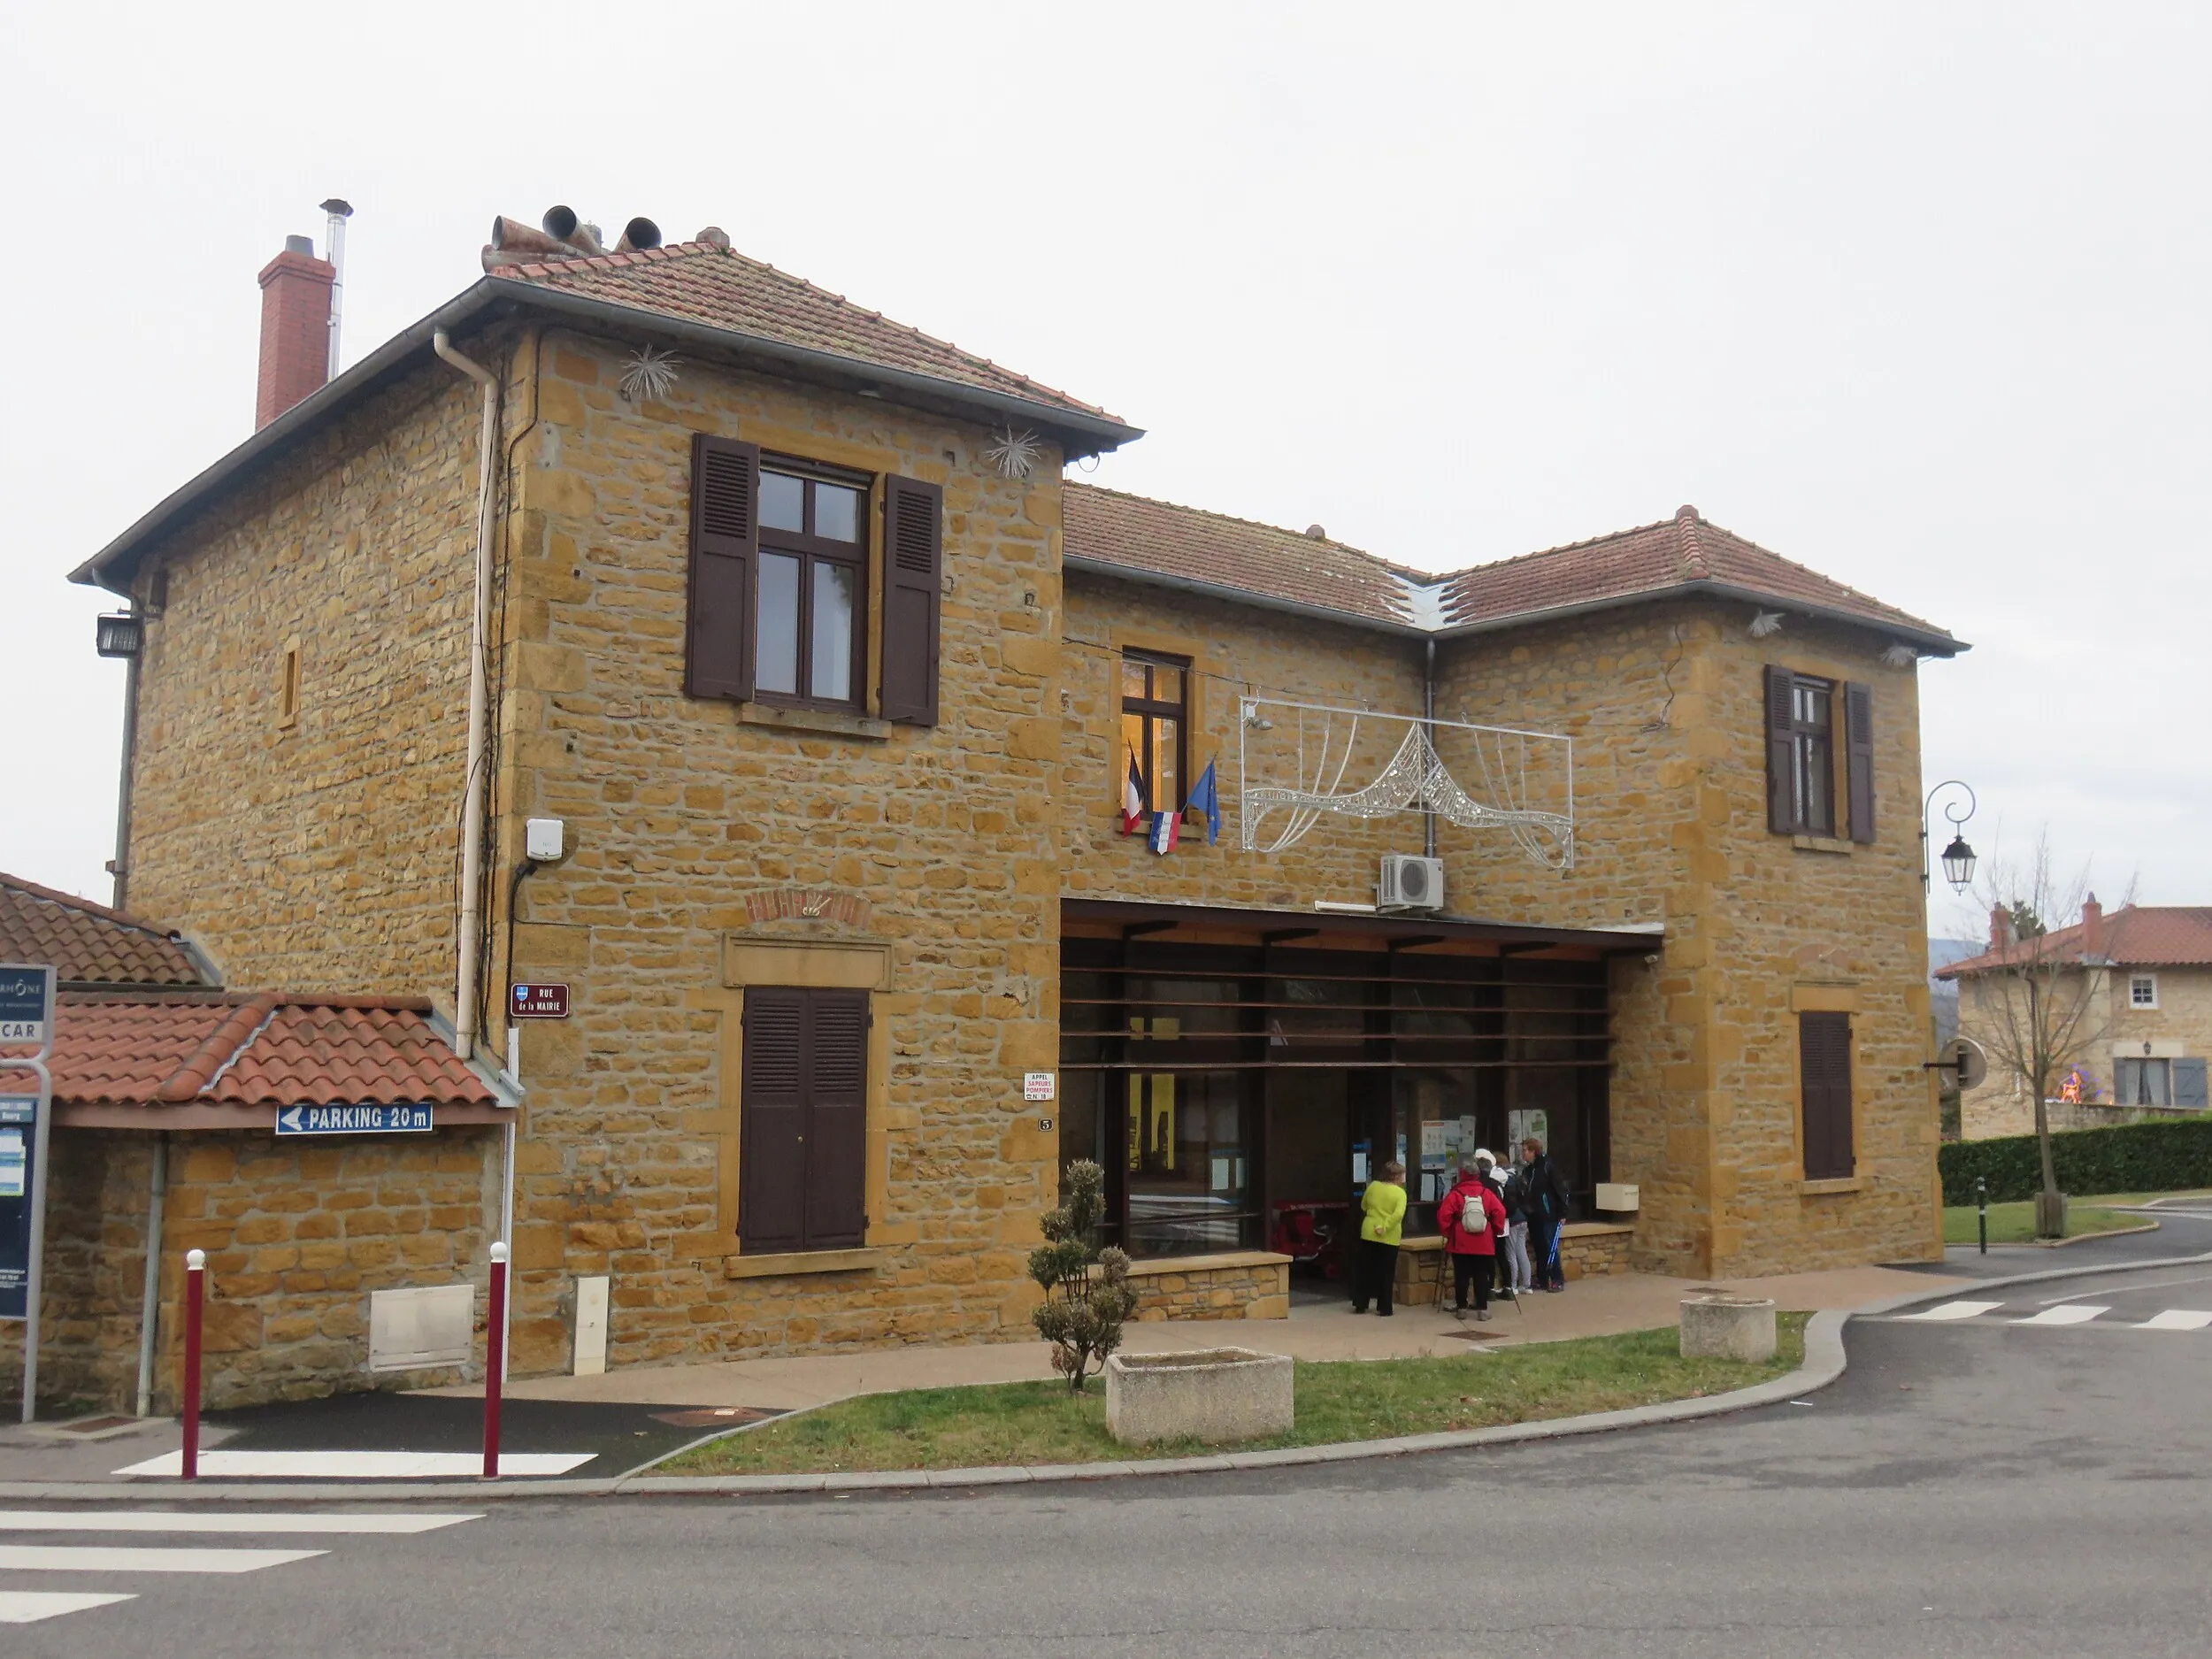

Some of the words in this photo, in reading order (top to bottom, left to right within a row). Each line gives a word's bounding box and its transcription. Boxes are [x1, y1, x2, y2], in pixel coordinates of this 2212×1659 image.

[539, 988, 554, 998] RUE
[518, 1002, 526, 1010] de
[528, 1002, 534, 1010] la
[536, 1002, 560, 1010] MAIRIE
[2, 1024, 35, 1037] CAR
[310, 1107, 382, 1128] PARKING
[390, 1107, 410, 1126] 20
[414, 1110, 426, 1126] m
[1042, 1120, 1049, 1129] 5
